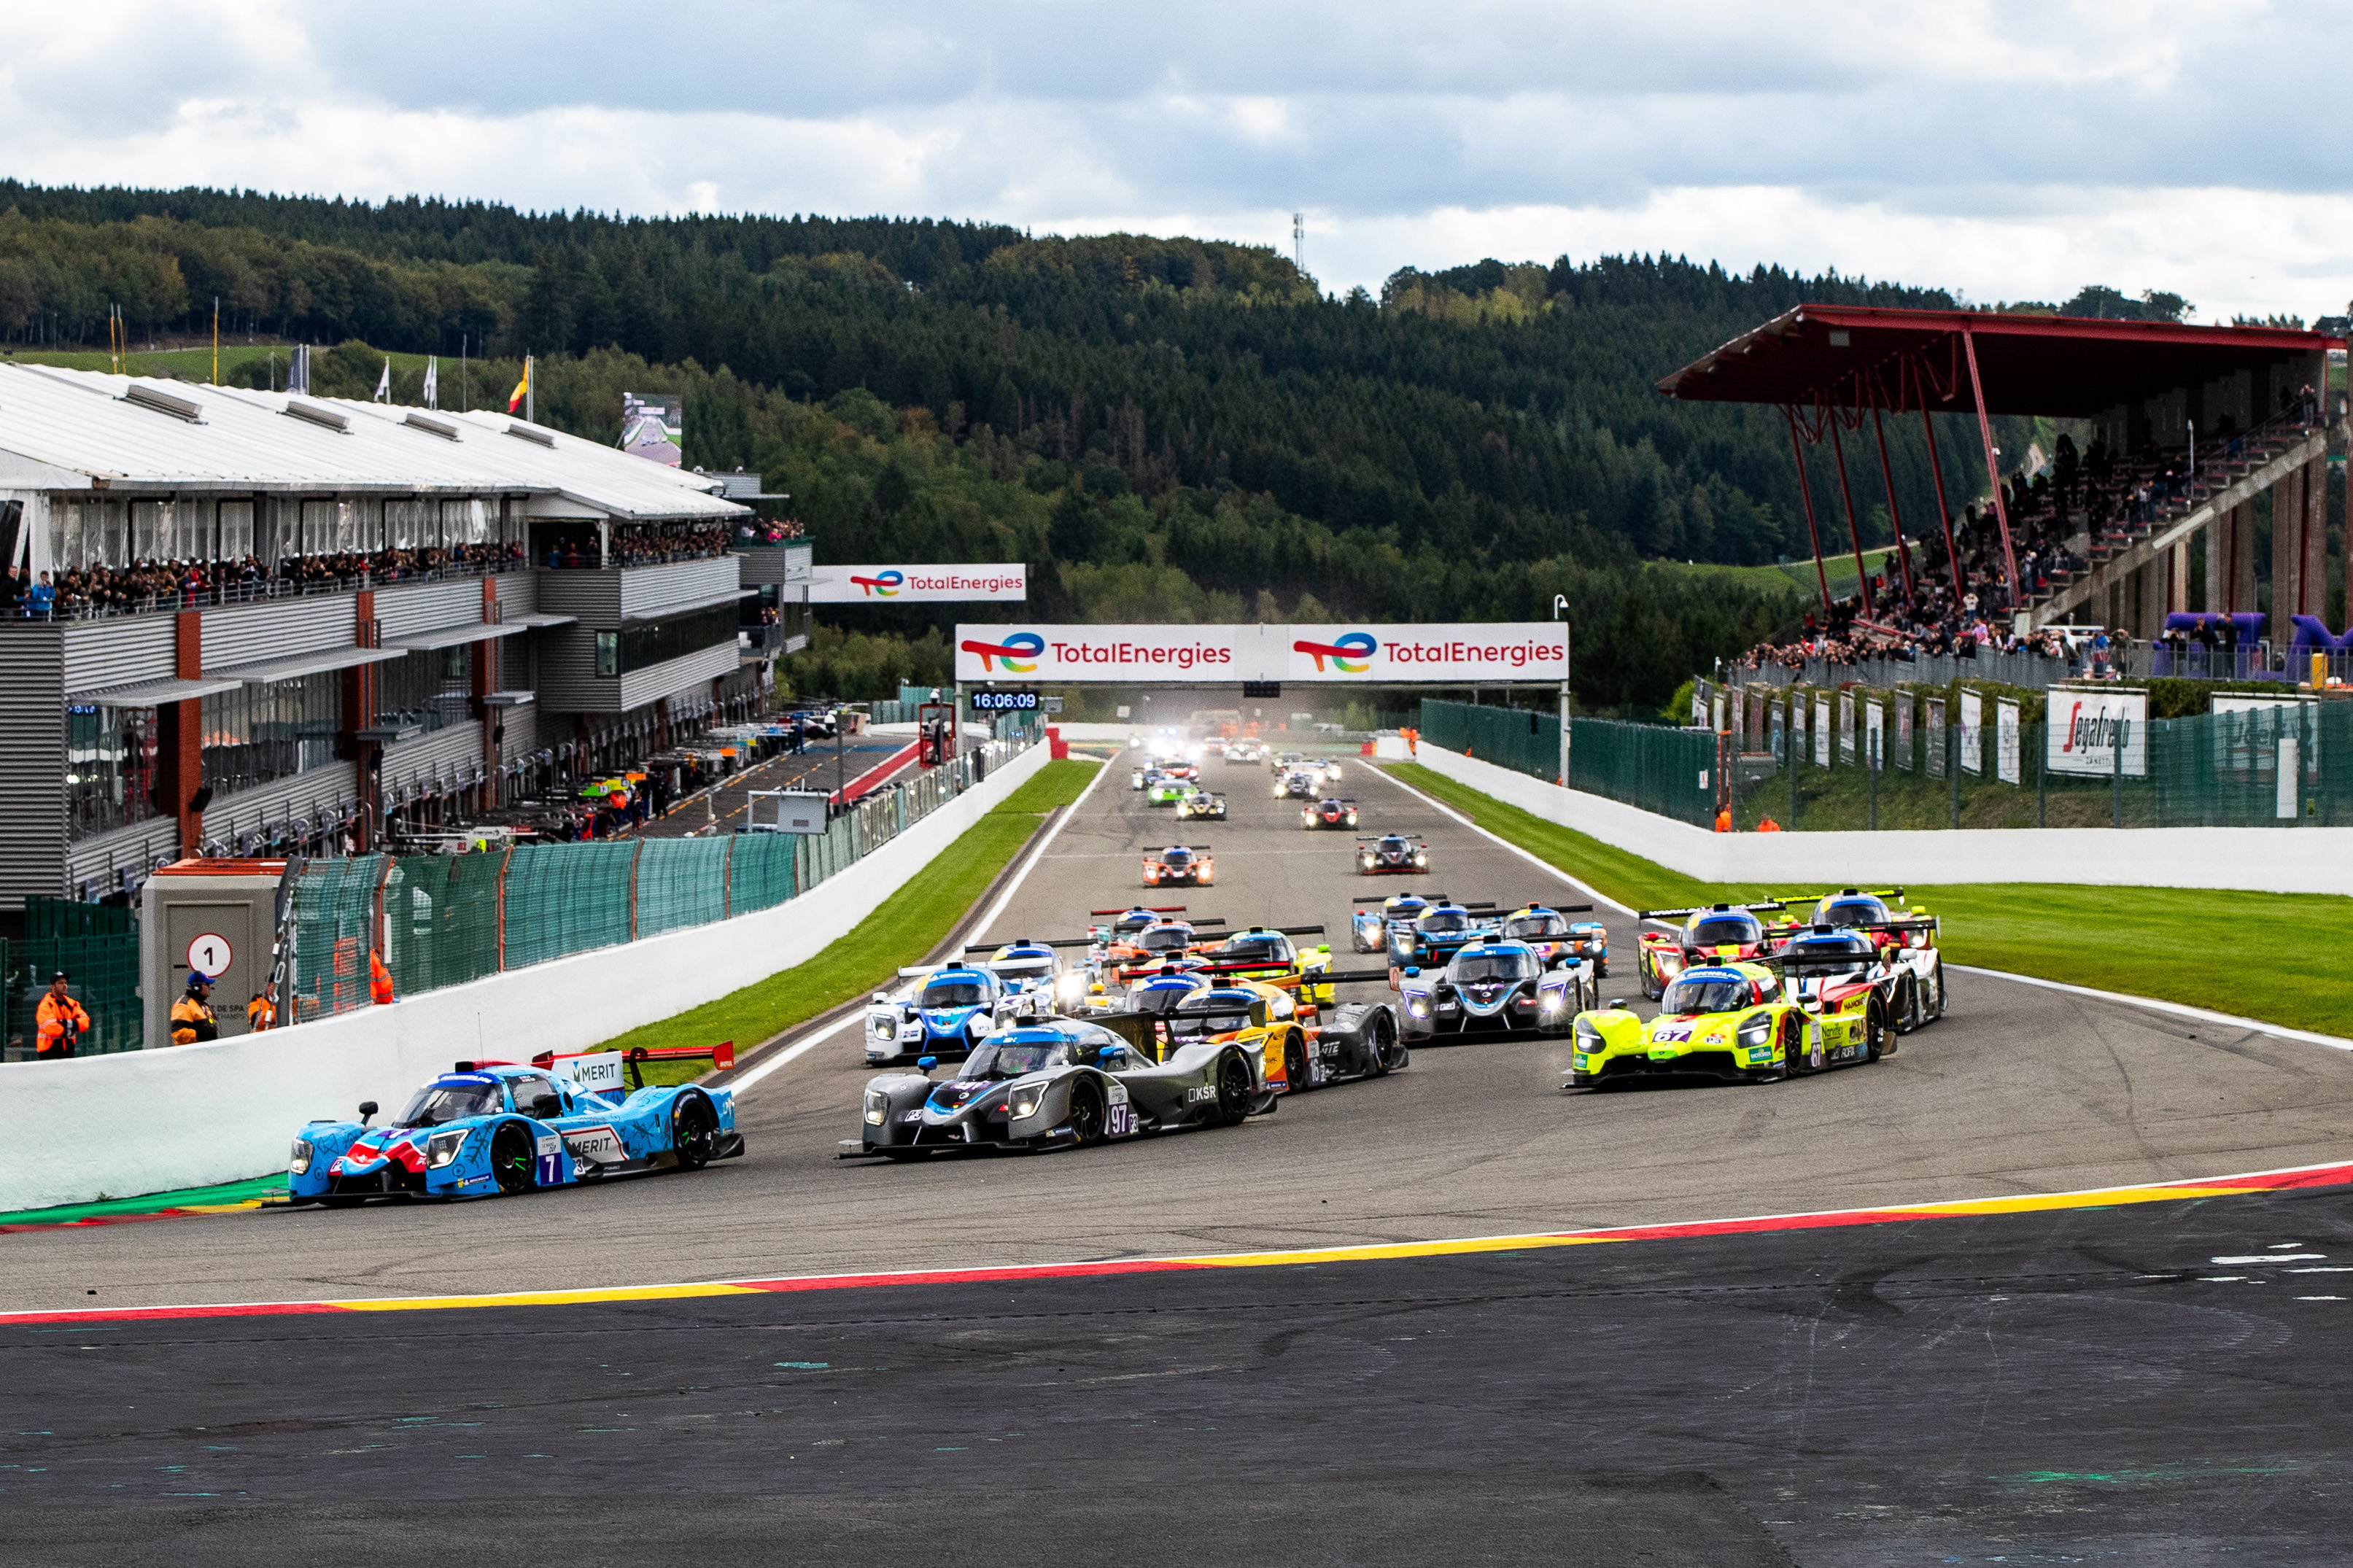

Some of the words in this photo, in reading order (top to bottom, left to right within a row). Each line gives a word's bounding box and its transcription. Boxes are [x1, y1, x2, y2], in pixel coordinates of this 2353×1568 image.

[908, 575, 1023, 592] TotalEnergies
[1051, 643, 1231, 668] TotalEnergies
[1384, 640, 1564, 667] TotalEnergies
[973, 694, 1036, 707] 16:06:09
[203, 947, 213, 966] 1
[1653, 1030, 1689, 1042] 67
[1811, 1044, 1821, 1068] 67
[582, 1063, 616, 1082] MERIT
[1310, 1058, 1319, 1082] 16
[907, 1111, 923, 1119] P3
[1111, 1104, 1128, 1133] 97
[571, 1137, 611, 1154] MERIT
[545, 1155, 555, 1182] 7
